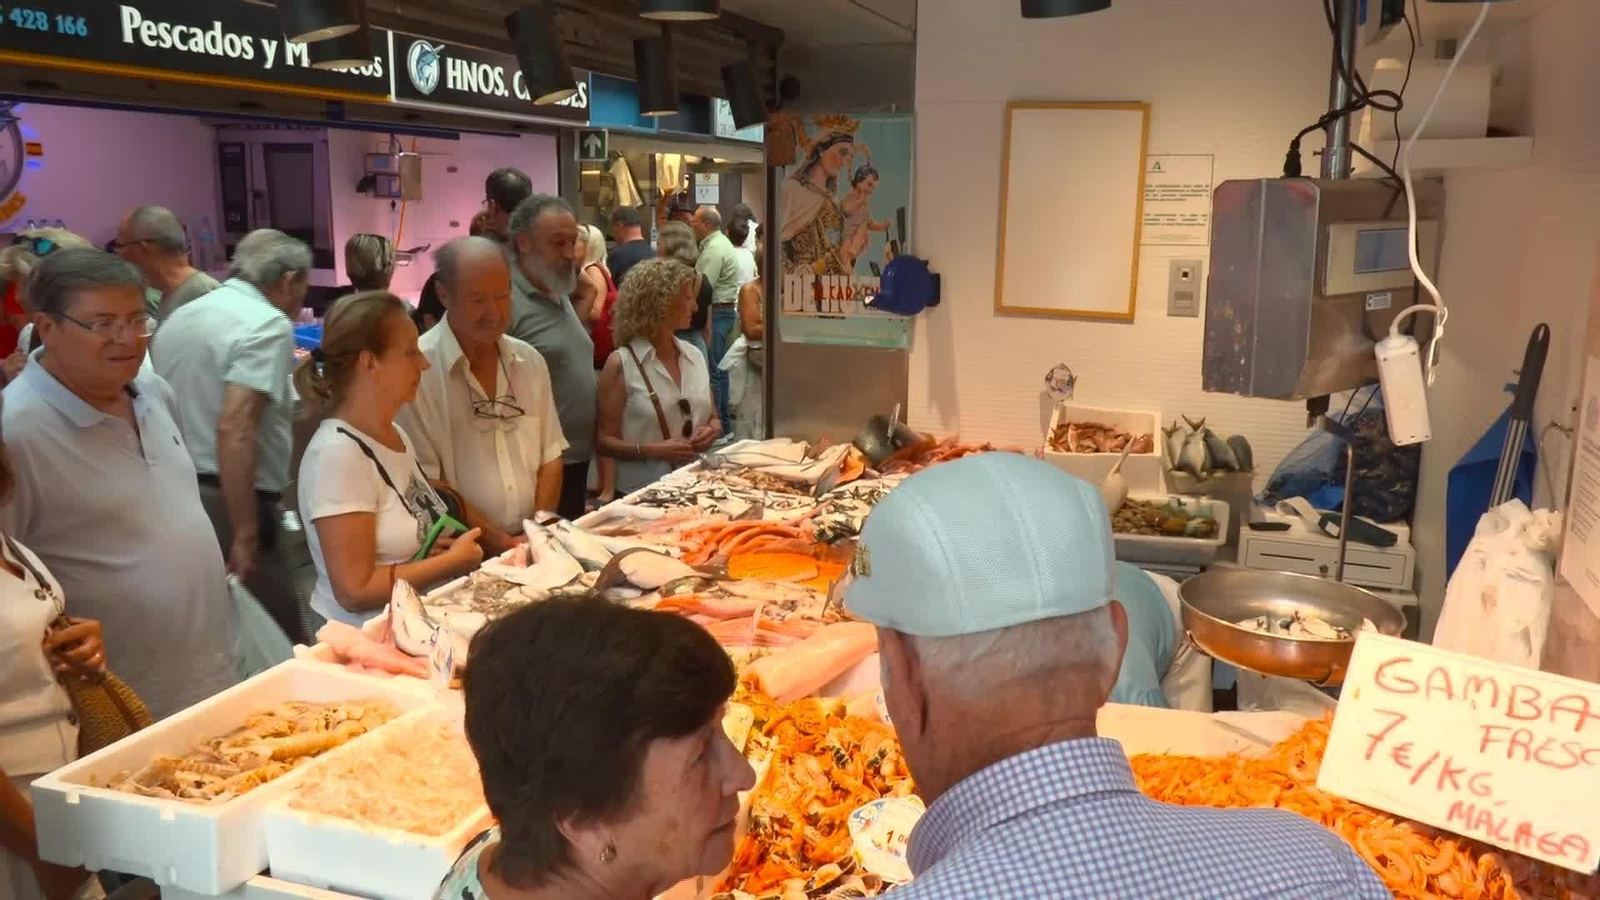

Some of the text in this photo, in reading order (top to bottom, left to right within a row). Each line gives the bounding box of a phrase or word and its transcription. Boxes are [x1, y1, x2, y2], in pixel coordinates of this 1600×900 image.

[9, 7, 49, 31] 428
[54, 14, 88, 37] 166
[120, 5, 254, 60] Pescados
[260, 38, 278, 69] y
[446, 57, 509, 98] HNOS.
[1374, 657, 1600, 732] GAMBA
